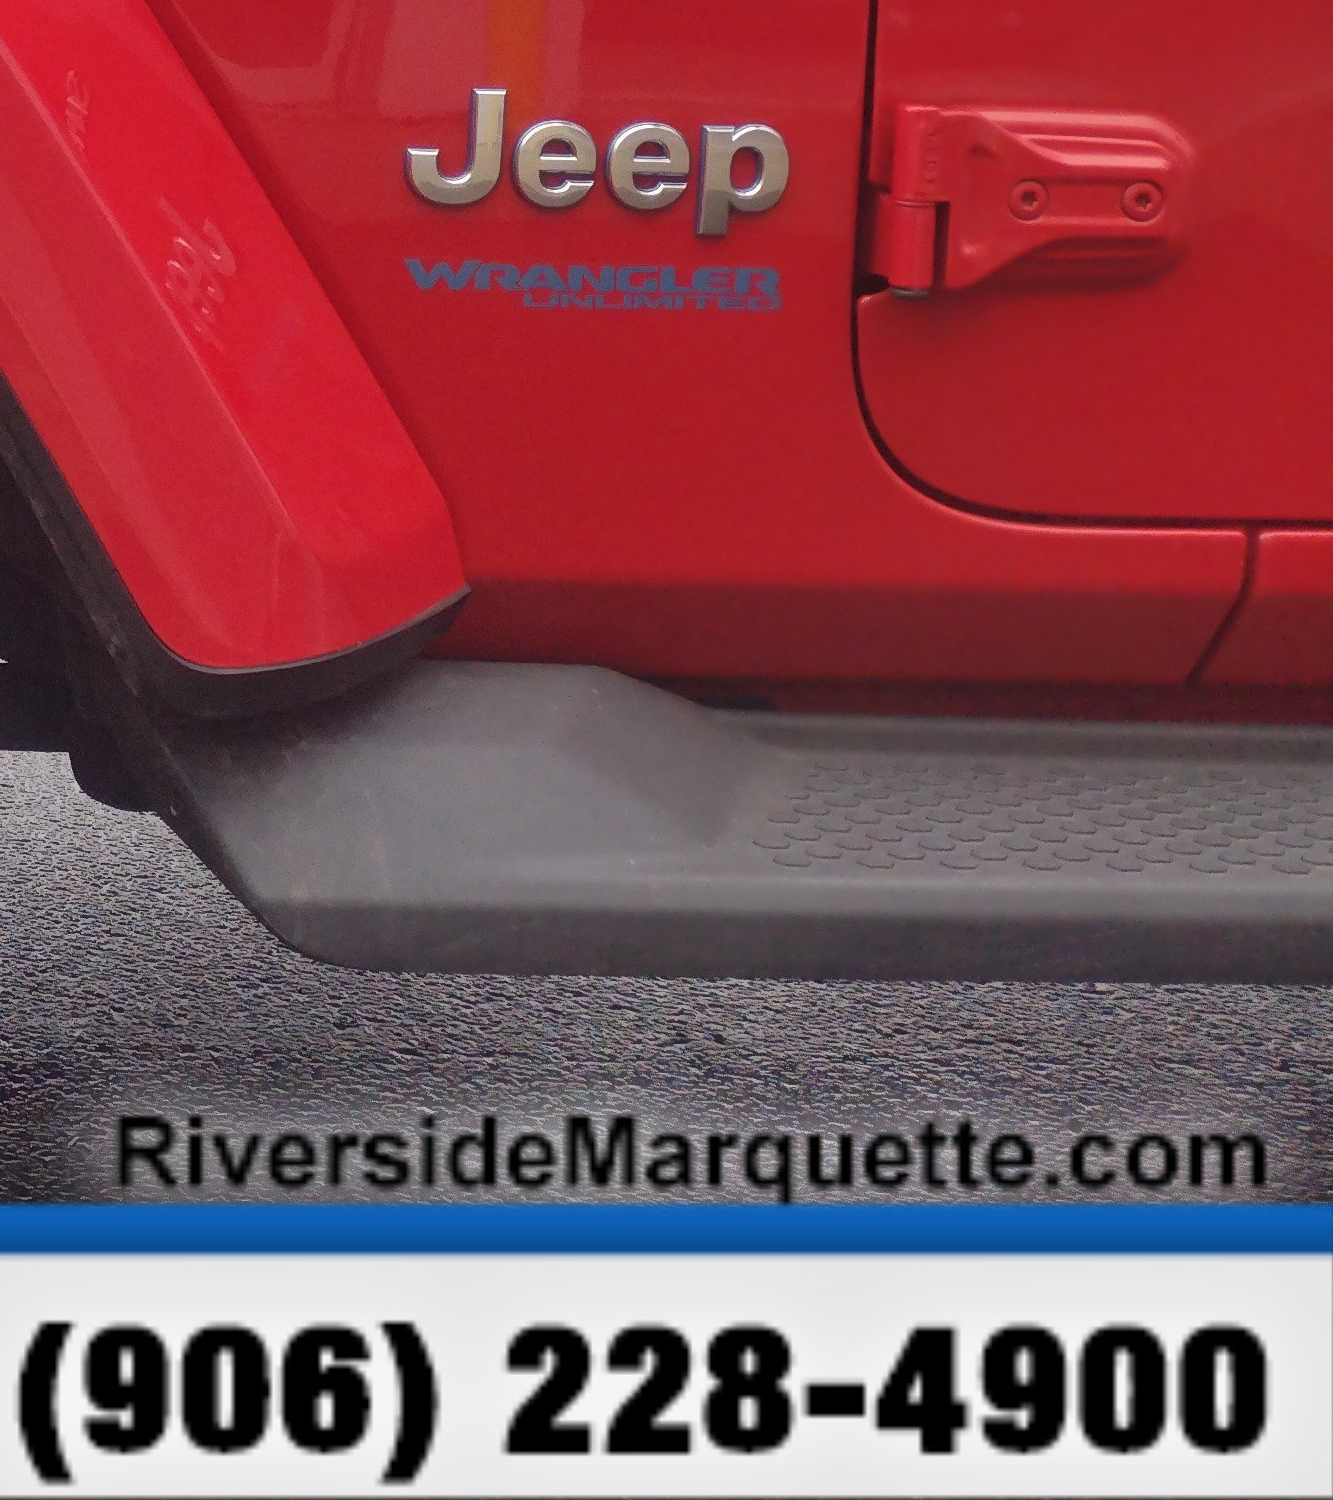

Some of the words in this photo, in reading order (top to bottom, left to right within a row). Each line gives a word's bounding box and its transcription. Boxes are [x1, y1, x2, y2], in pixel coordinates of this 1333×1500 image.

[405, 86, 791, 236] Jeep
[404, 258, 782, 296] WRANGLER
[523, 292, 782, 311] UNLIMITED
